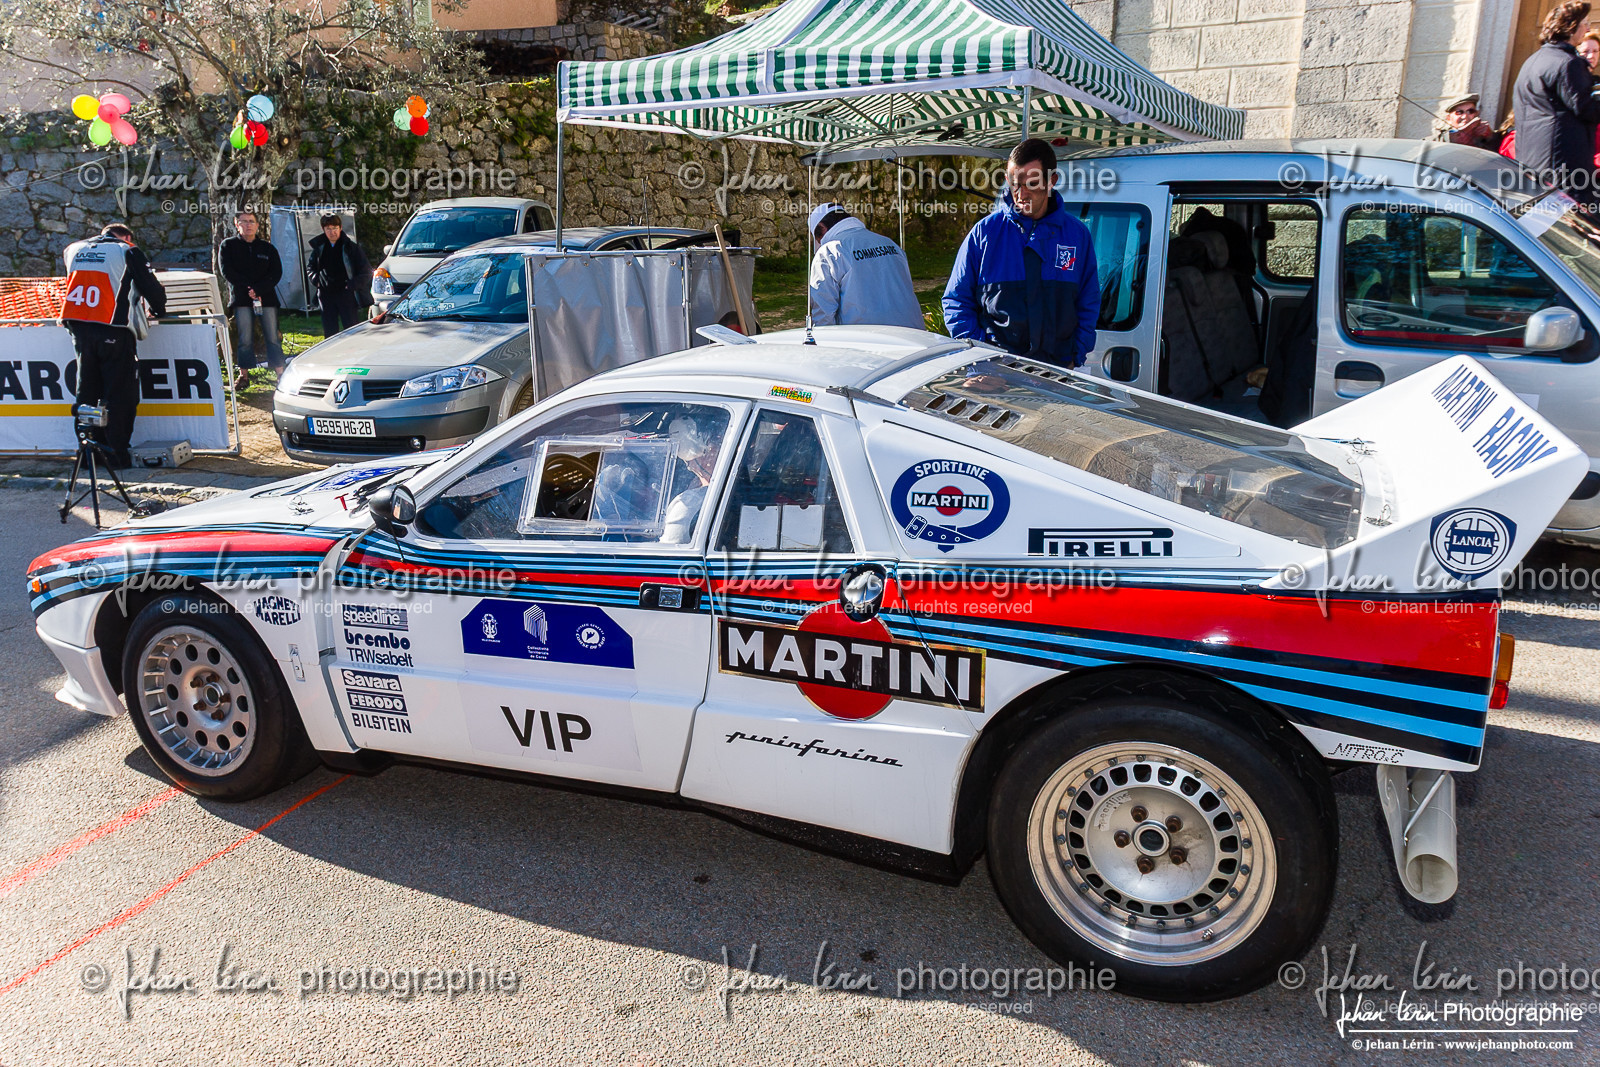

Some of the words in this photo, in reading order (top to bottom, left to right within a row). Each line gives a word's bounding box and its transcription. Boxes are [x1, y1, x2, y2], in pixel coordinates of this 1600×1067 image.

[67, 285, 100, 308] 40
[0, 358, 212, 401] ÄRER
[1431, 364, 1498, 432] MARTINI
[316, 419, 342, 434] 9595
[914, 460, 990, 481] SPORTLINE
[912, 492, 988, 510] MARTINI
[1027, 527, 1174, 557] PIRELLI
[1452, 533, 1493, 548] LANCIA
[343, 607, 401, 626] speedline
[343, 628, 411, 650] brembo
[727, 626, 971, 702] MARTINI
[342, 670, 401, 691] Savara
[349, 693, 404, 711] FERODO
[352, 712, 412, 734] BILSTEIN
[500, 705, 592, 753] VIP
[725, 729, 904, 767] pininfarina
